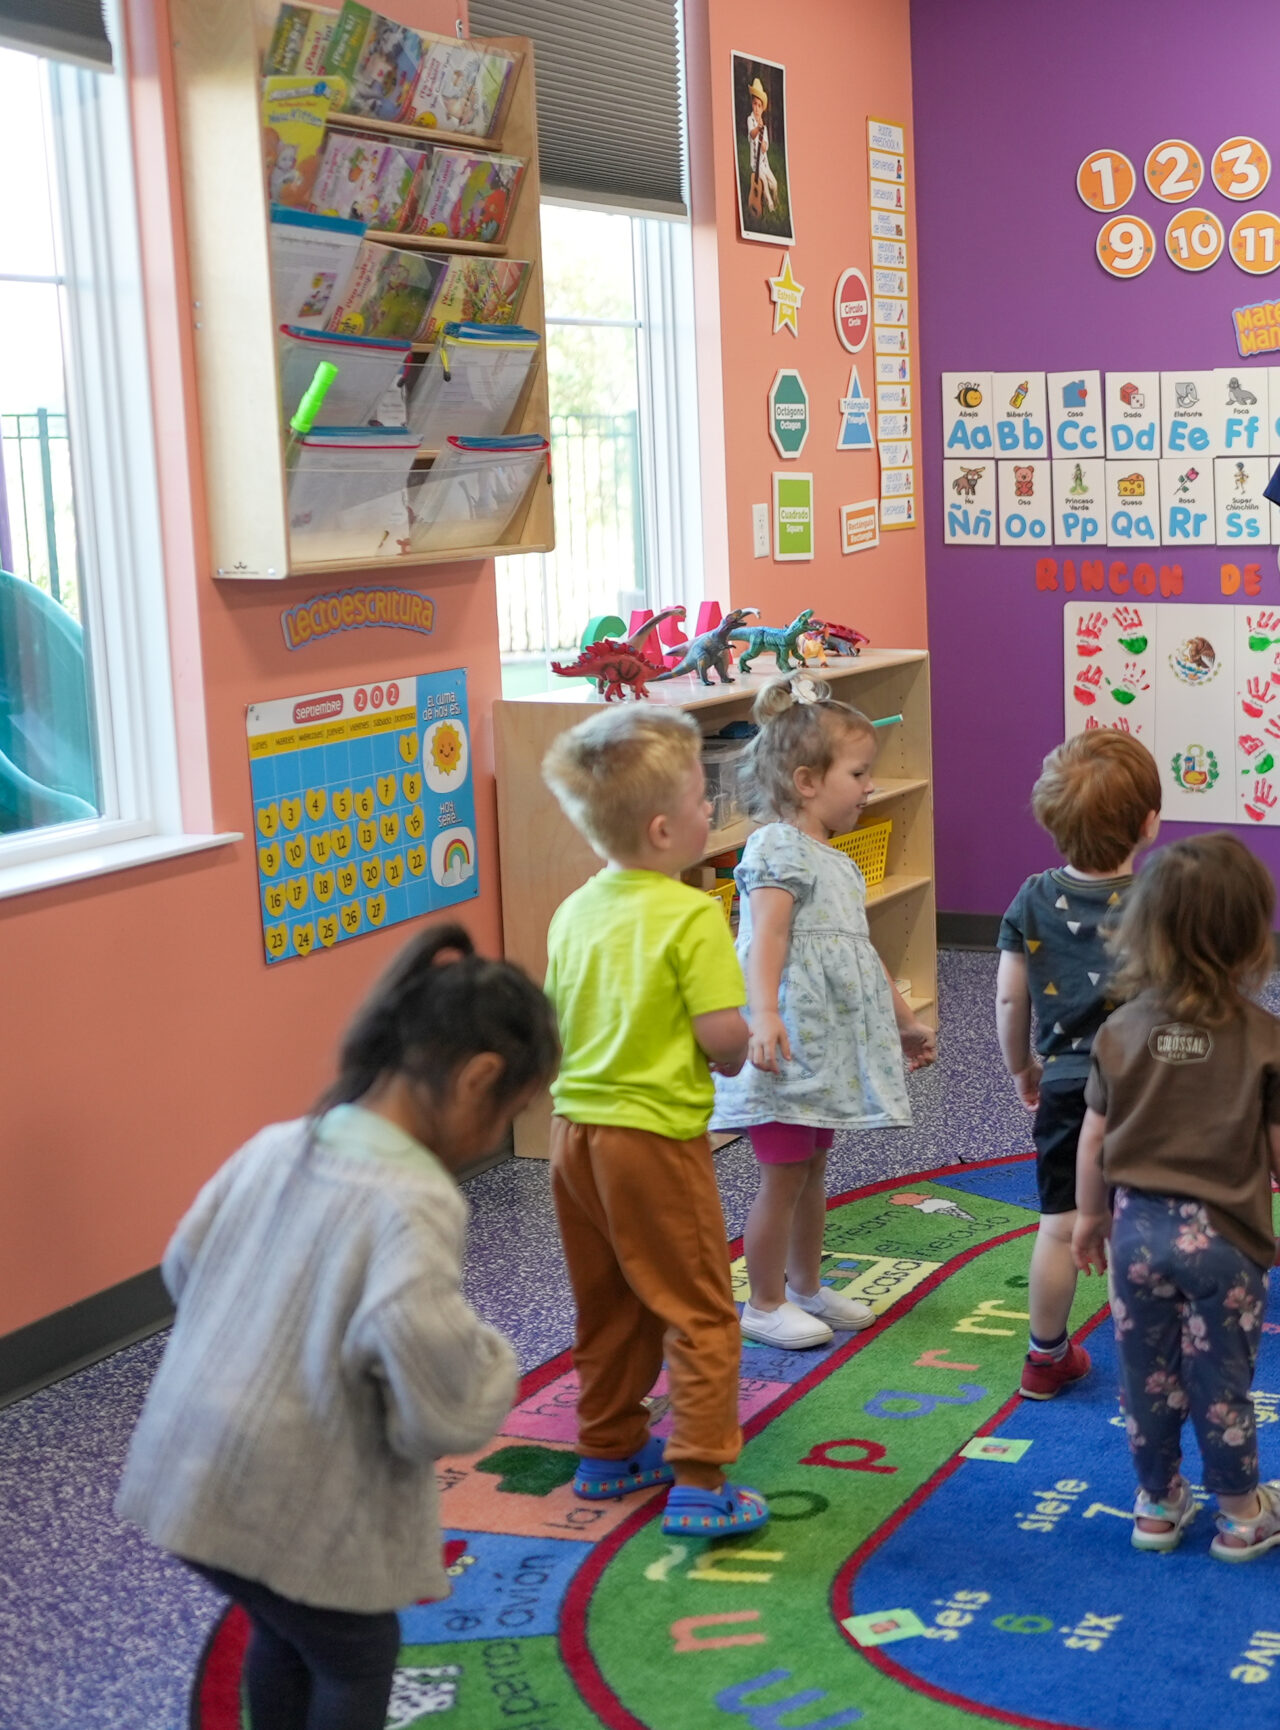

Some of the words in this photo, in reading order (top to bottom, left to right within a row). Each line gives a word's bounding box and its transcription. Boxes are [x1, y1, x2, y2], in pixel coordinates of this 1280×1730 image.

[1091, 157, 1116, 204] 1
[1157, 146, 1194, 196] 2
[1220, 143, 1260, 194] 3
[1110, 221, 1144, 270] 9
[1171, 222, 1218, 259] 10
[1240, 228, 1275, 261] 11
[947, 419, 992, 450] Aa
[997, 418, 1044, 451] Bb
[1057, 420, 1098, 450] Cc
[1111, 422, 1156, 452] Dd
[1168, 420, 1210, 451] Ee
[1225, 416, 1259, 448] Ff
[948, 503, 992, 538] Ññ
[1005, 513, 1046, 539] Oo
[1062, 512, 1098, 543] Pp
[1169, 506, 1208, 539] Rr
[1226, 512, 1260, 538] Ss
[1035, 557, 1184, 598] RINCON
[1220, 563, 1262, 596] DE
[357, 693, 365, 708] 2
[373, 691, 381, 705] 0
[389, 688, 396, 702] 2
[406, 742, 412, 756] 1
[265, 815, 272, 829] 2
[288, 807, 294, 822] 3
[312, 799, 319, 812] 4
[340, 798, 346, 812] 5
[361, 799, 368, 811] 6
[384, 784, 390, 797] 7
[409, 781, 415, 794] 8
[266, 854, 273, 868] 9
[290, 845, 301, 861] 10
[317, 842, 325, 856] 11
[337, 835, 346, 850] 12
[363, 830, 371, 843] 13
[385, 822, 395, 836] 14
[411, 818, 420, 833] 15
[270, 893, 281, 908] 16
[293, 886, 302, 901] 17
[319, 880, 328, 894] 18
[343, 873, 352, 887] 19
[366, 866, 377, 881] 20
[390, 865, 399, 880] 21
[412, 854, 423, 869] 22
[271, 934, 283, 948] 23
[298, 933, 310, 947] 24
[323, 924, 334, 938] 25
[346, 910, 357, 926] 26
[372, 903, 381, 918] 27
[1157, 1035, 1205, 1054] COLOSSAL
[862, 1259, 923, 1296] casa
[863, 1383, 988, 1420] q
[798, 1438, 899, 1475] p
[1014, 1478, 1089, 1533] siete
[494, 1553, 558, 1629] avión
[670, 1610, 768, 1653] n
[923, 1589, 992, 1642] seis
[992, 1613, 1054, 1635] 6
[1058, 1611, 1124, 1652] six
